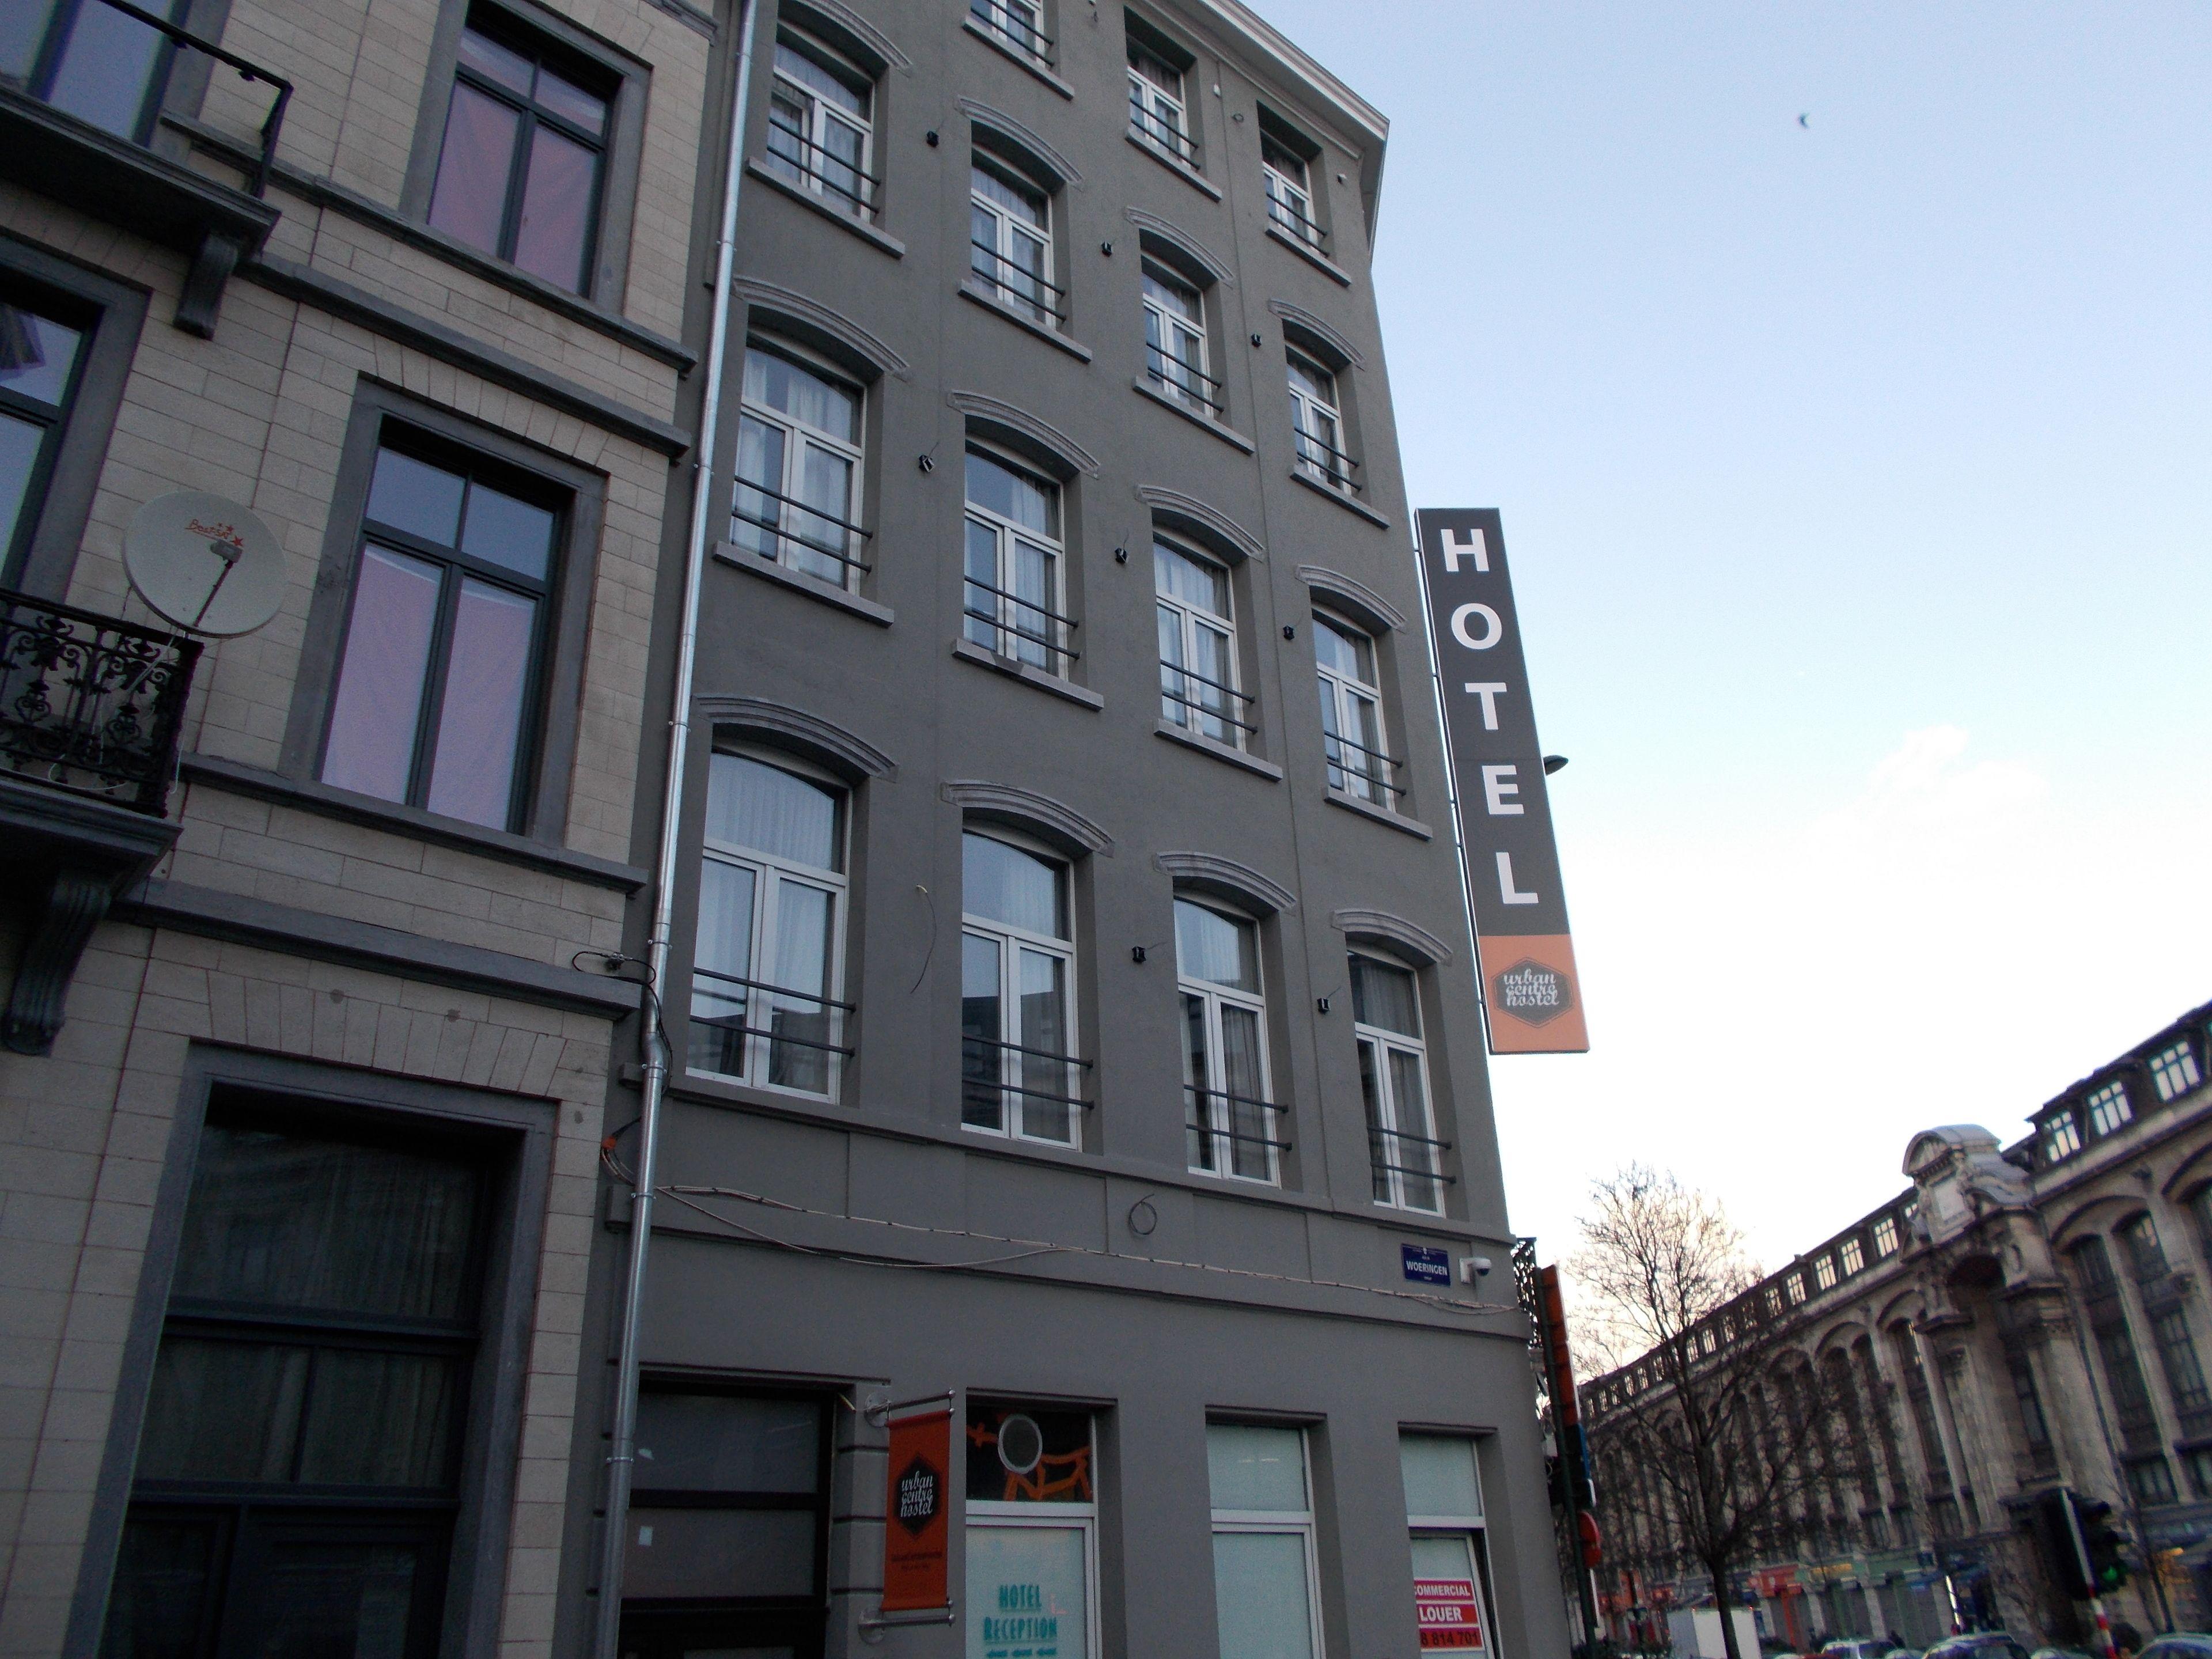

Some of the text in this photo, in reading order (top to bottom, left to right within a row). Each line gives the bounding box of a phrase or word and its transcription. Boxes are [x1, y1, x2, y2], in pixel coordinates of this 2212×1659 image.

[1441, 528, 1539, 904] HOTEL
[1503, 968, 1556, 984] urban
[1506, 983, 1556, 995] centre
[1506, 990, 1560, 1006] hostel
[1406, 1260, 1448, 1276] WOERINGEN
[902, 1471, 934, 1491] urban
[902, 1486, 933, 1504] centre
[900, 1498, 933, 1517] hostel
[999, 1584, 1042, 1608] HOTEL
[1419, 1606, 1463, 1622] LOUER
[984, 1616, 1058, 1641] RECEPTION
